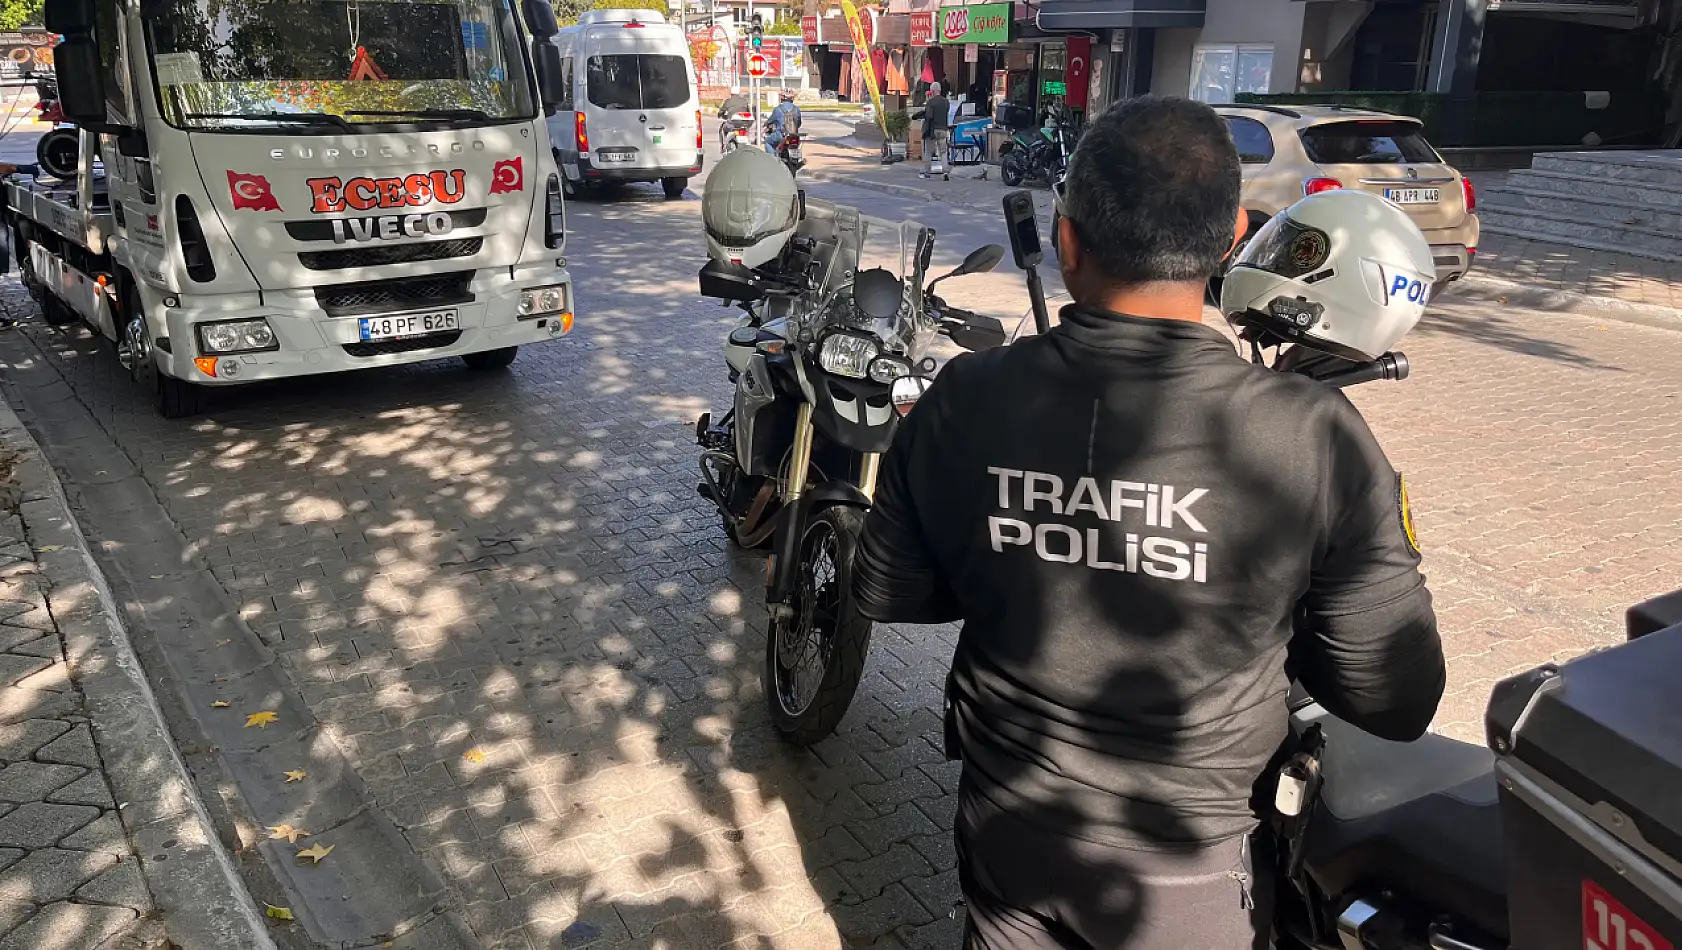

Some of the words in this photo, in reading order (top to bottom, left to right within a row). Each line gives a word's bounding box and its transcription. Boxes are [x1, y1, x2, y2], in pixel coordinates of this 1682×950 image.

[270, 140, 485, 160] EUROCARGO
[306, 169, 467, 213] ECESU
[331, 212, 452, 244] IVECO
[370, 320, 392, 335] 48
[396, 317, 417, 333] PF
[423, 313, 455, 330] 626
